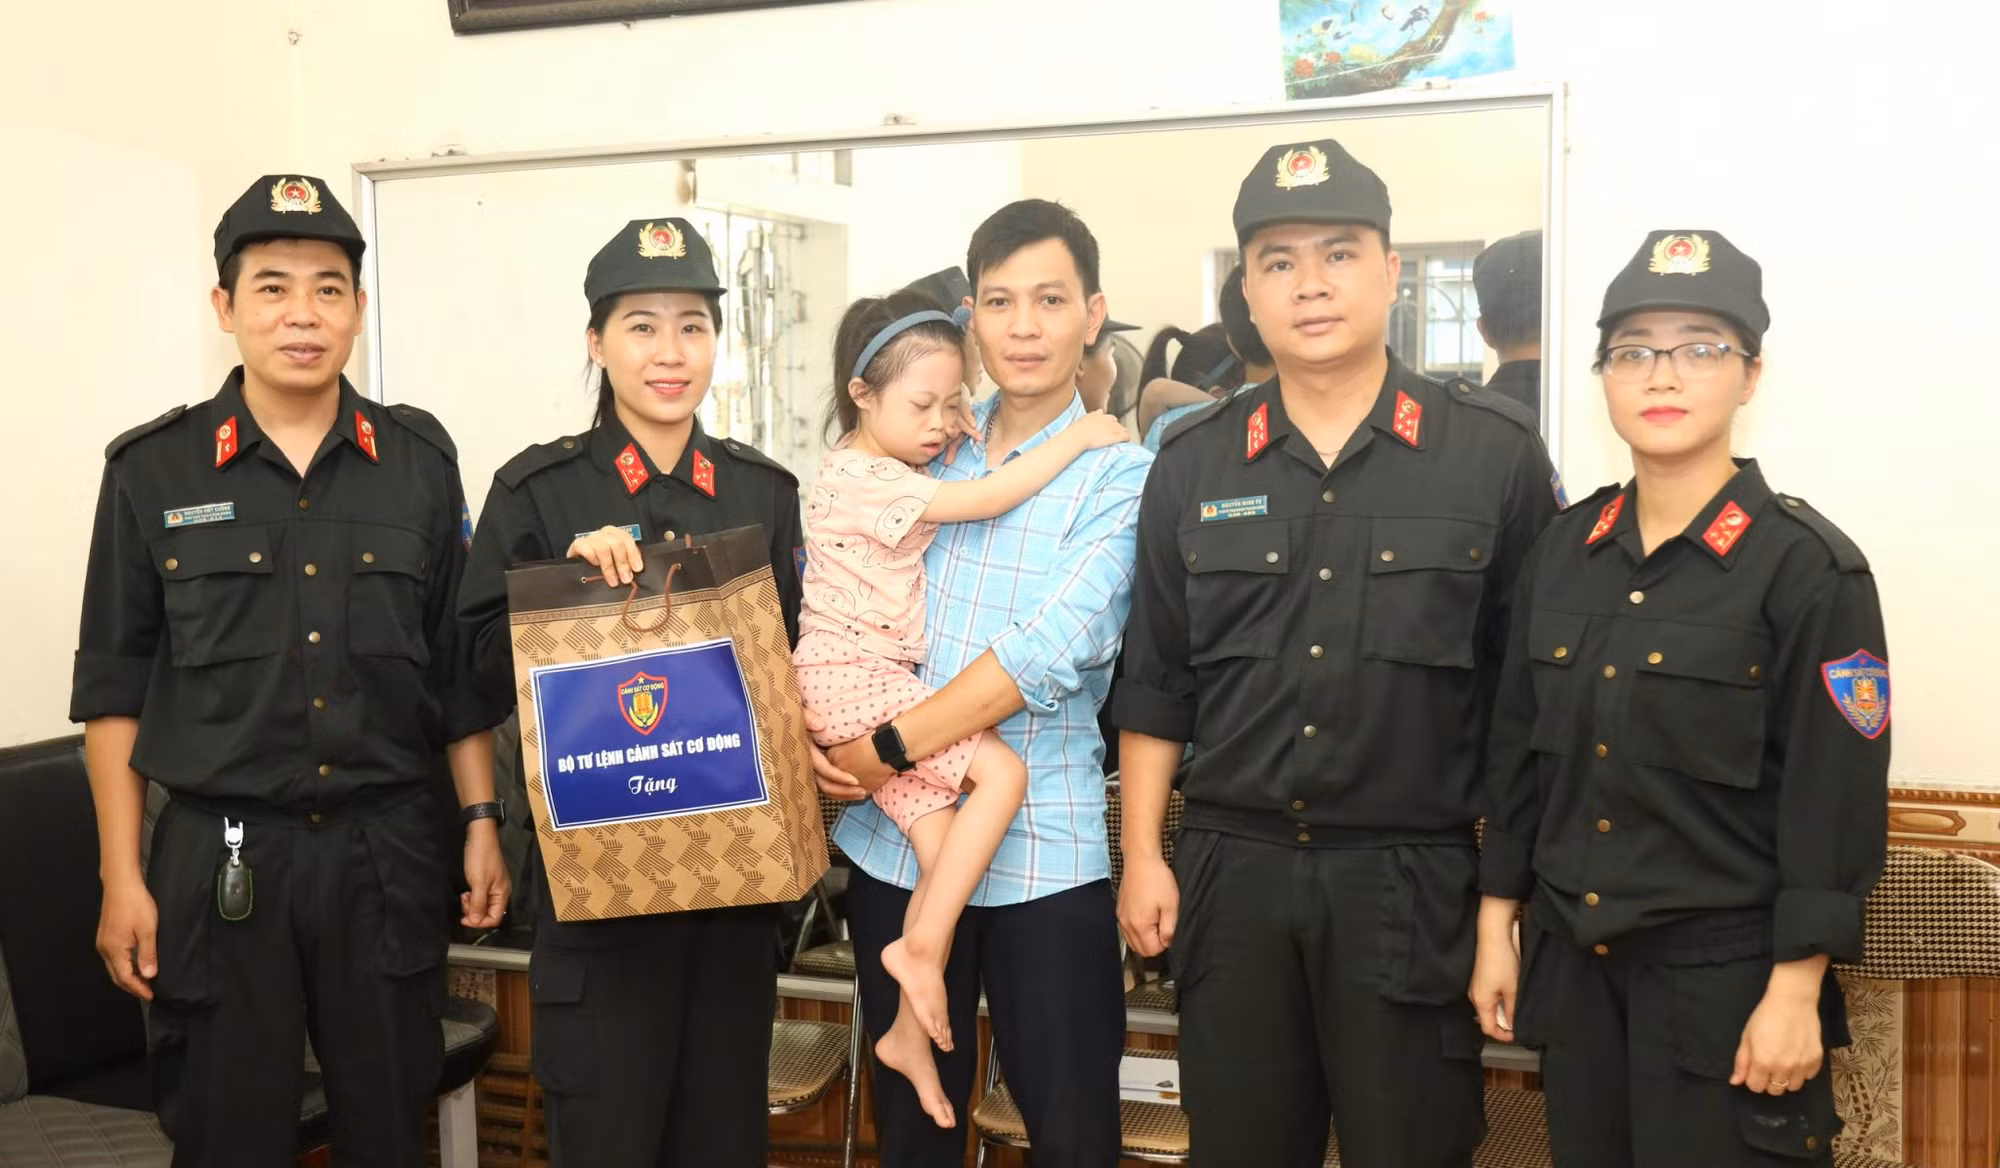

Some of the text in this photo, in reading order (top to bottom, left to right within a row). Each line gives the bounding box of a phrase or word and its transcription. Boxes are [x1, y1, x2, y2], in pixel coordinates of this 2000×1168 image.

[558, 733, 741, 774] BỘ TƯ LỆNH CẢNH SÁT CƠ ĐỘNG
[628, 776, 678, 796] Tặng
